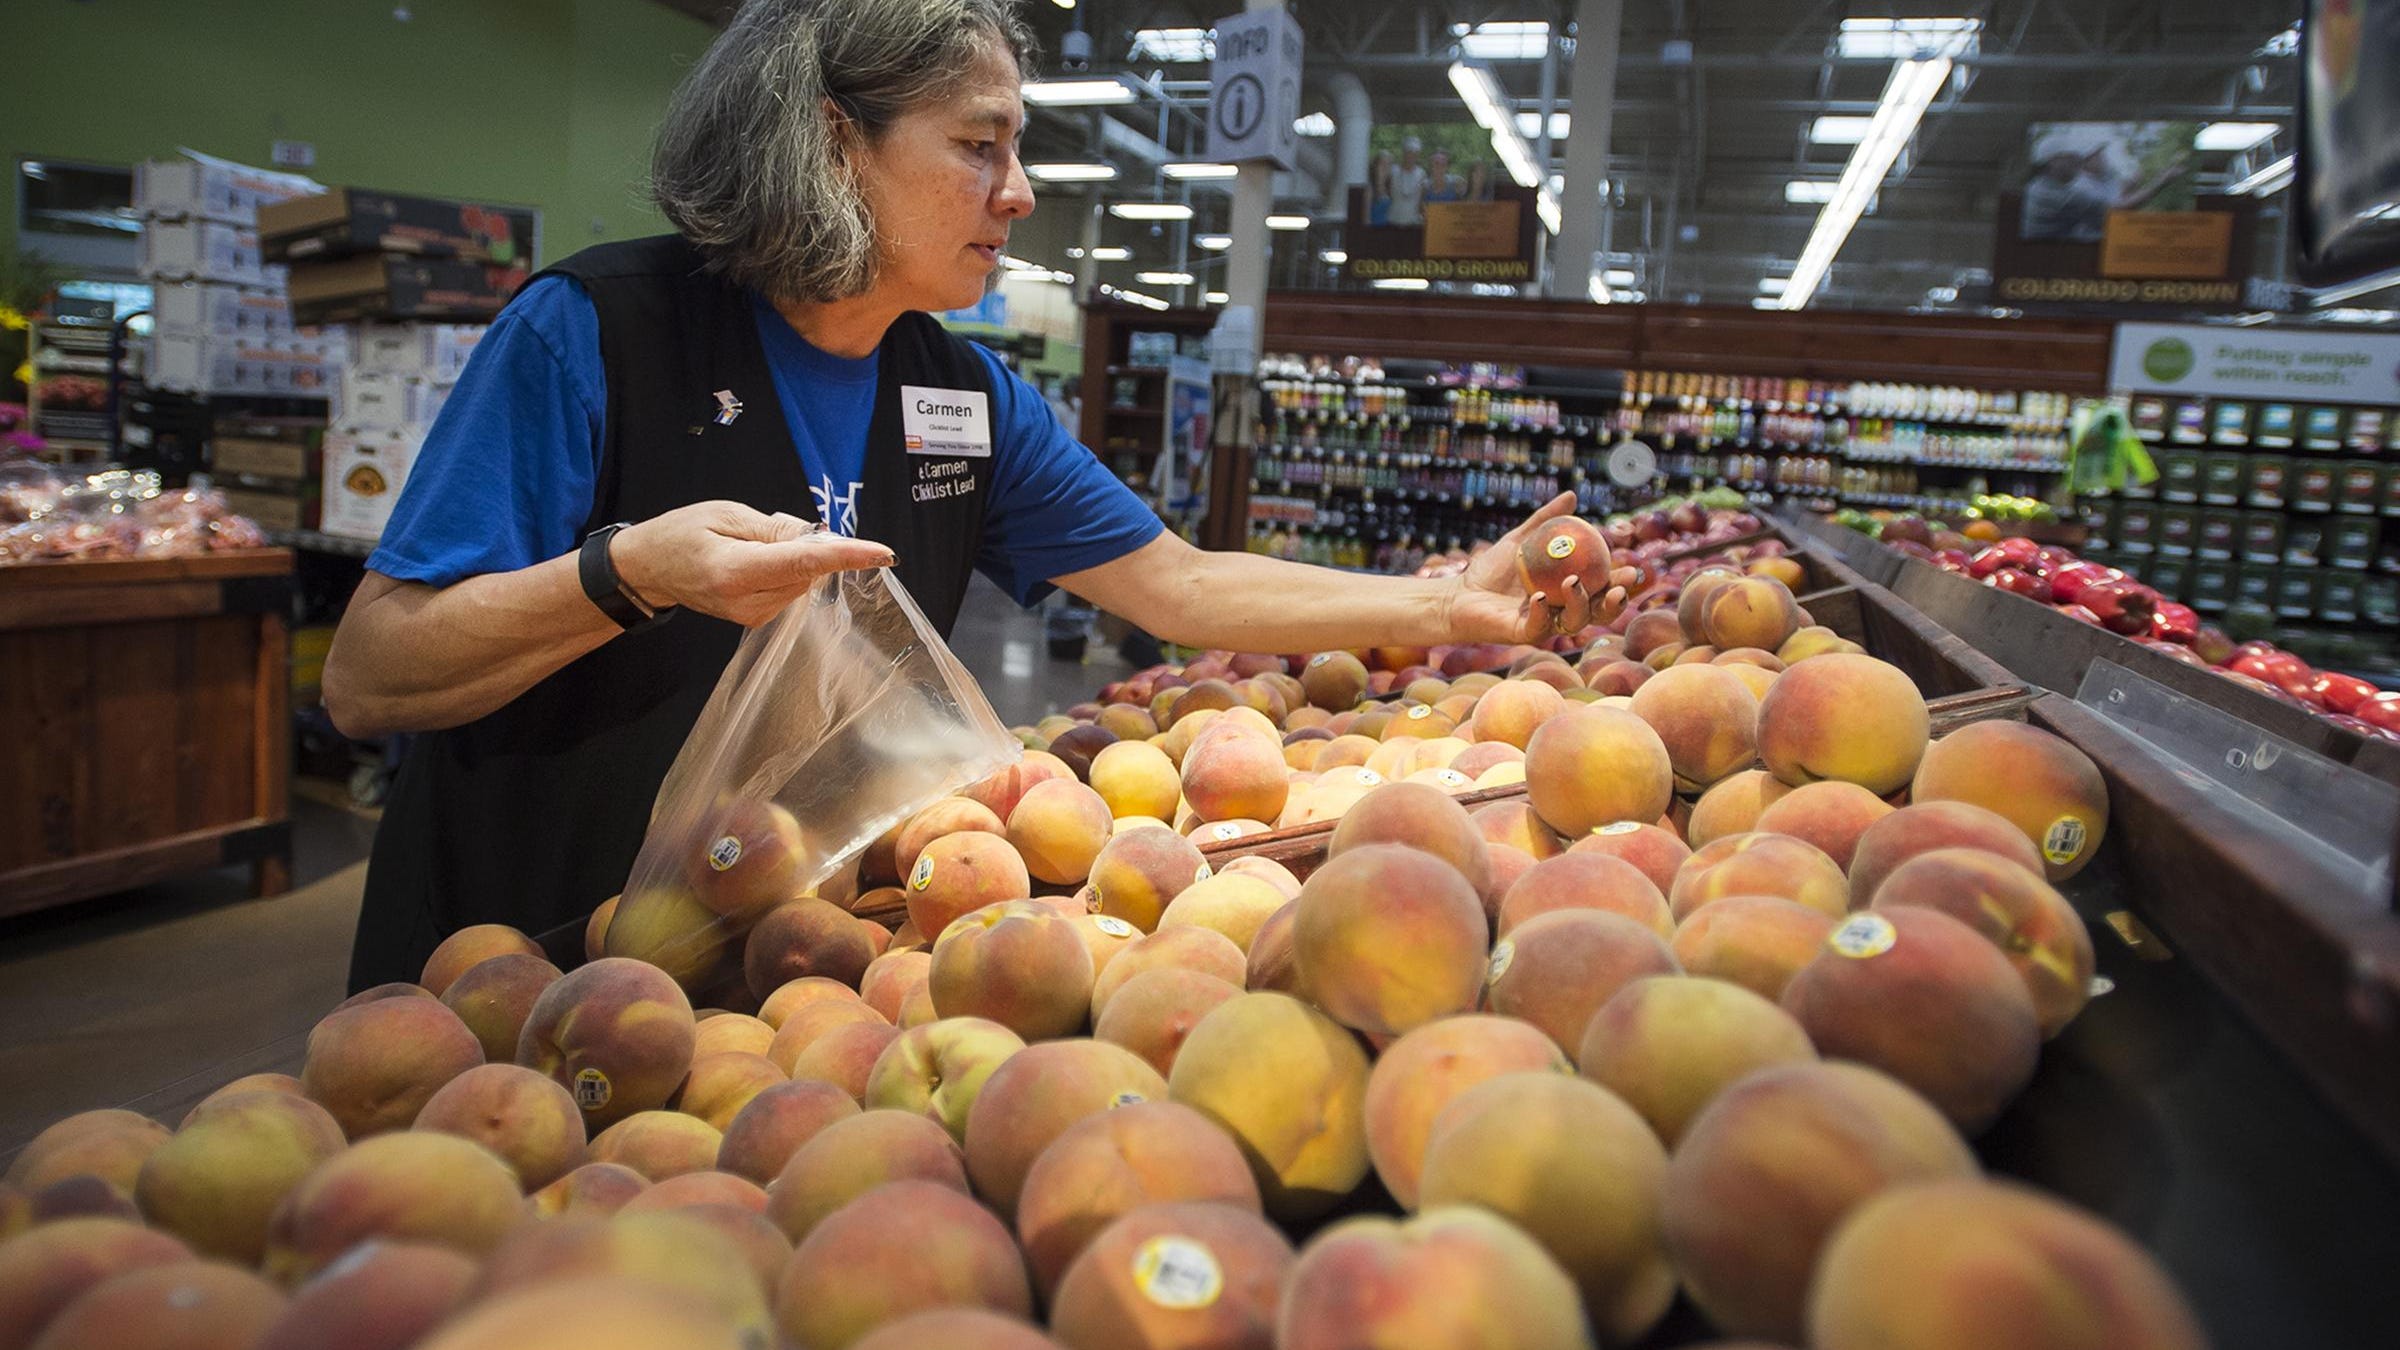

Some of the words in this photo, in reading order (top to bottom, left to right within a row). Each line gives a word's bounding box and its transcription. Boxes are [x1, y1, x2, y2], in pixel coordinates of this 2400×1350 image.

[1222, 26, 1269, 61] INFO
[1354, 260, 1453, 276] COLORADO
[1457, 261, 1528, 277] GROWN
[2002, 279, 2138, 299] COLORADO
[2141, 281, 2238, 300] GROWN
[2213, 346, 2292, 365] Putting
[2300, 352, 2372, 367] simple
[2213, 367, 2277, 380] within
[917, 400, 972, 417] Carmen
[924, 460, 968, 478] Carmen
[953, 474, 975, 496] Lead
